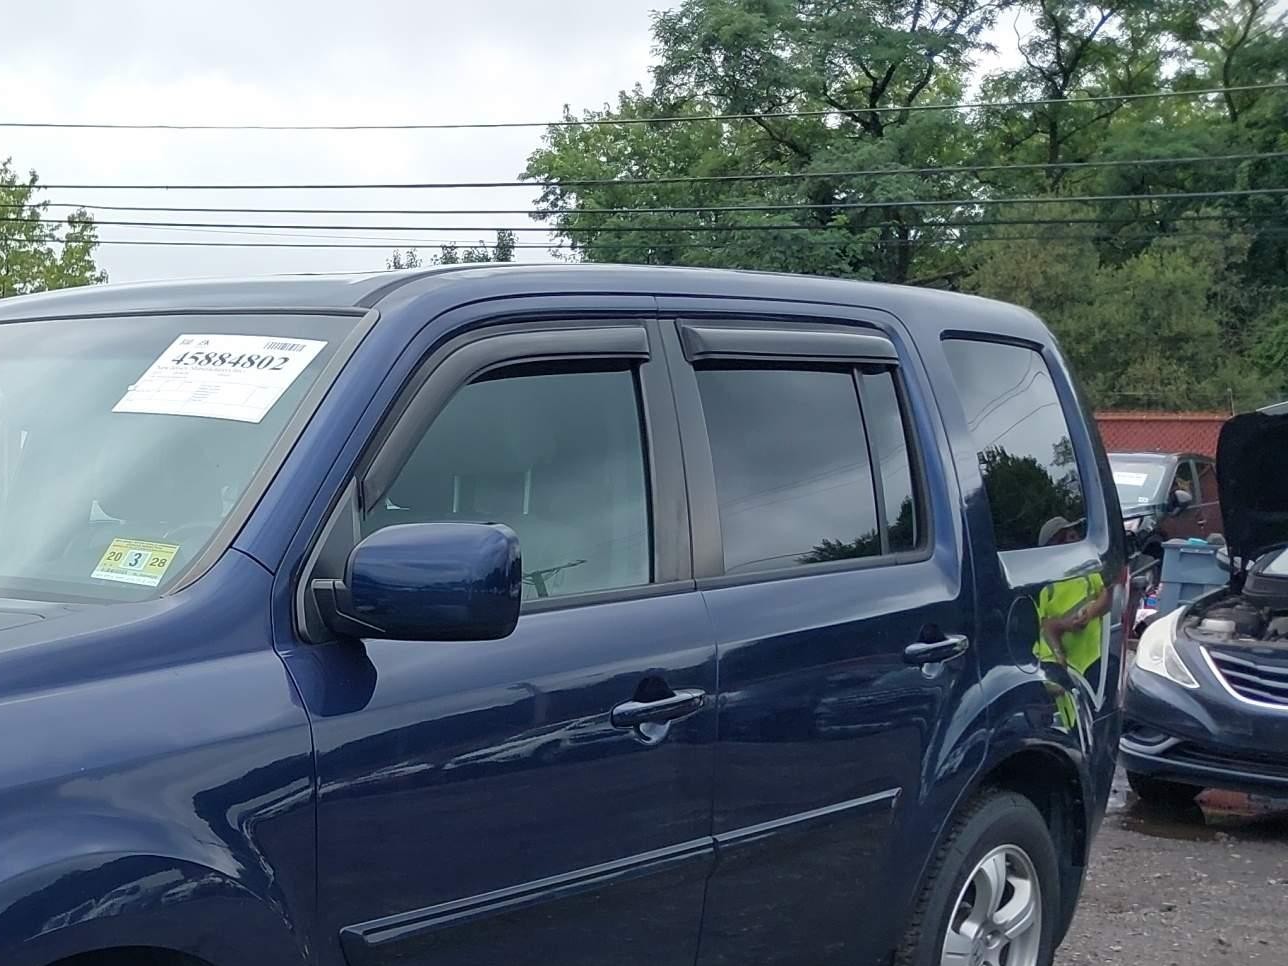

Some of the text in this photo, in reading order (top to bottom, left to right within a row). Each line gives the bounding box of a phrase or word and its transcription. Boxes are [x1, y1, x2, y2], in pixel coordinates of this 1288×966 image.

[171, 351, 290, 371] 45884802
[107, 551, 167, 568] 20 3 28
